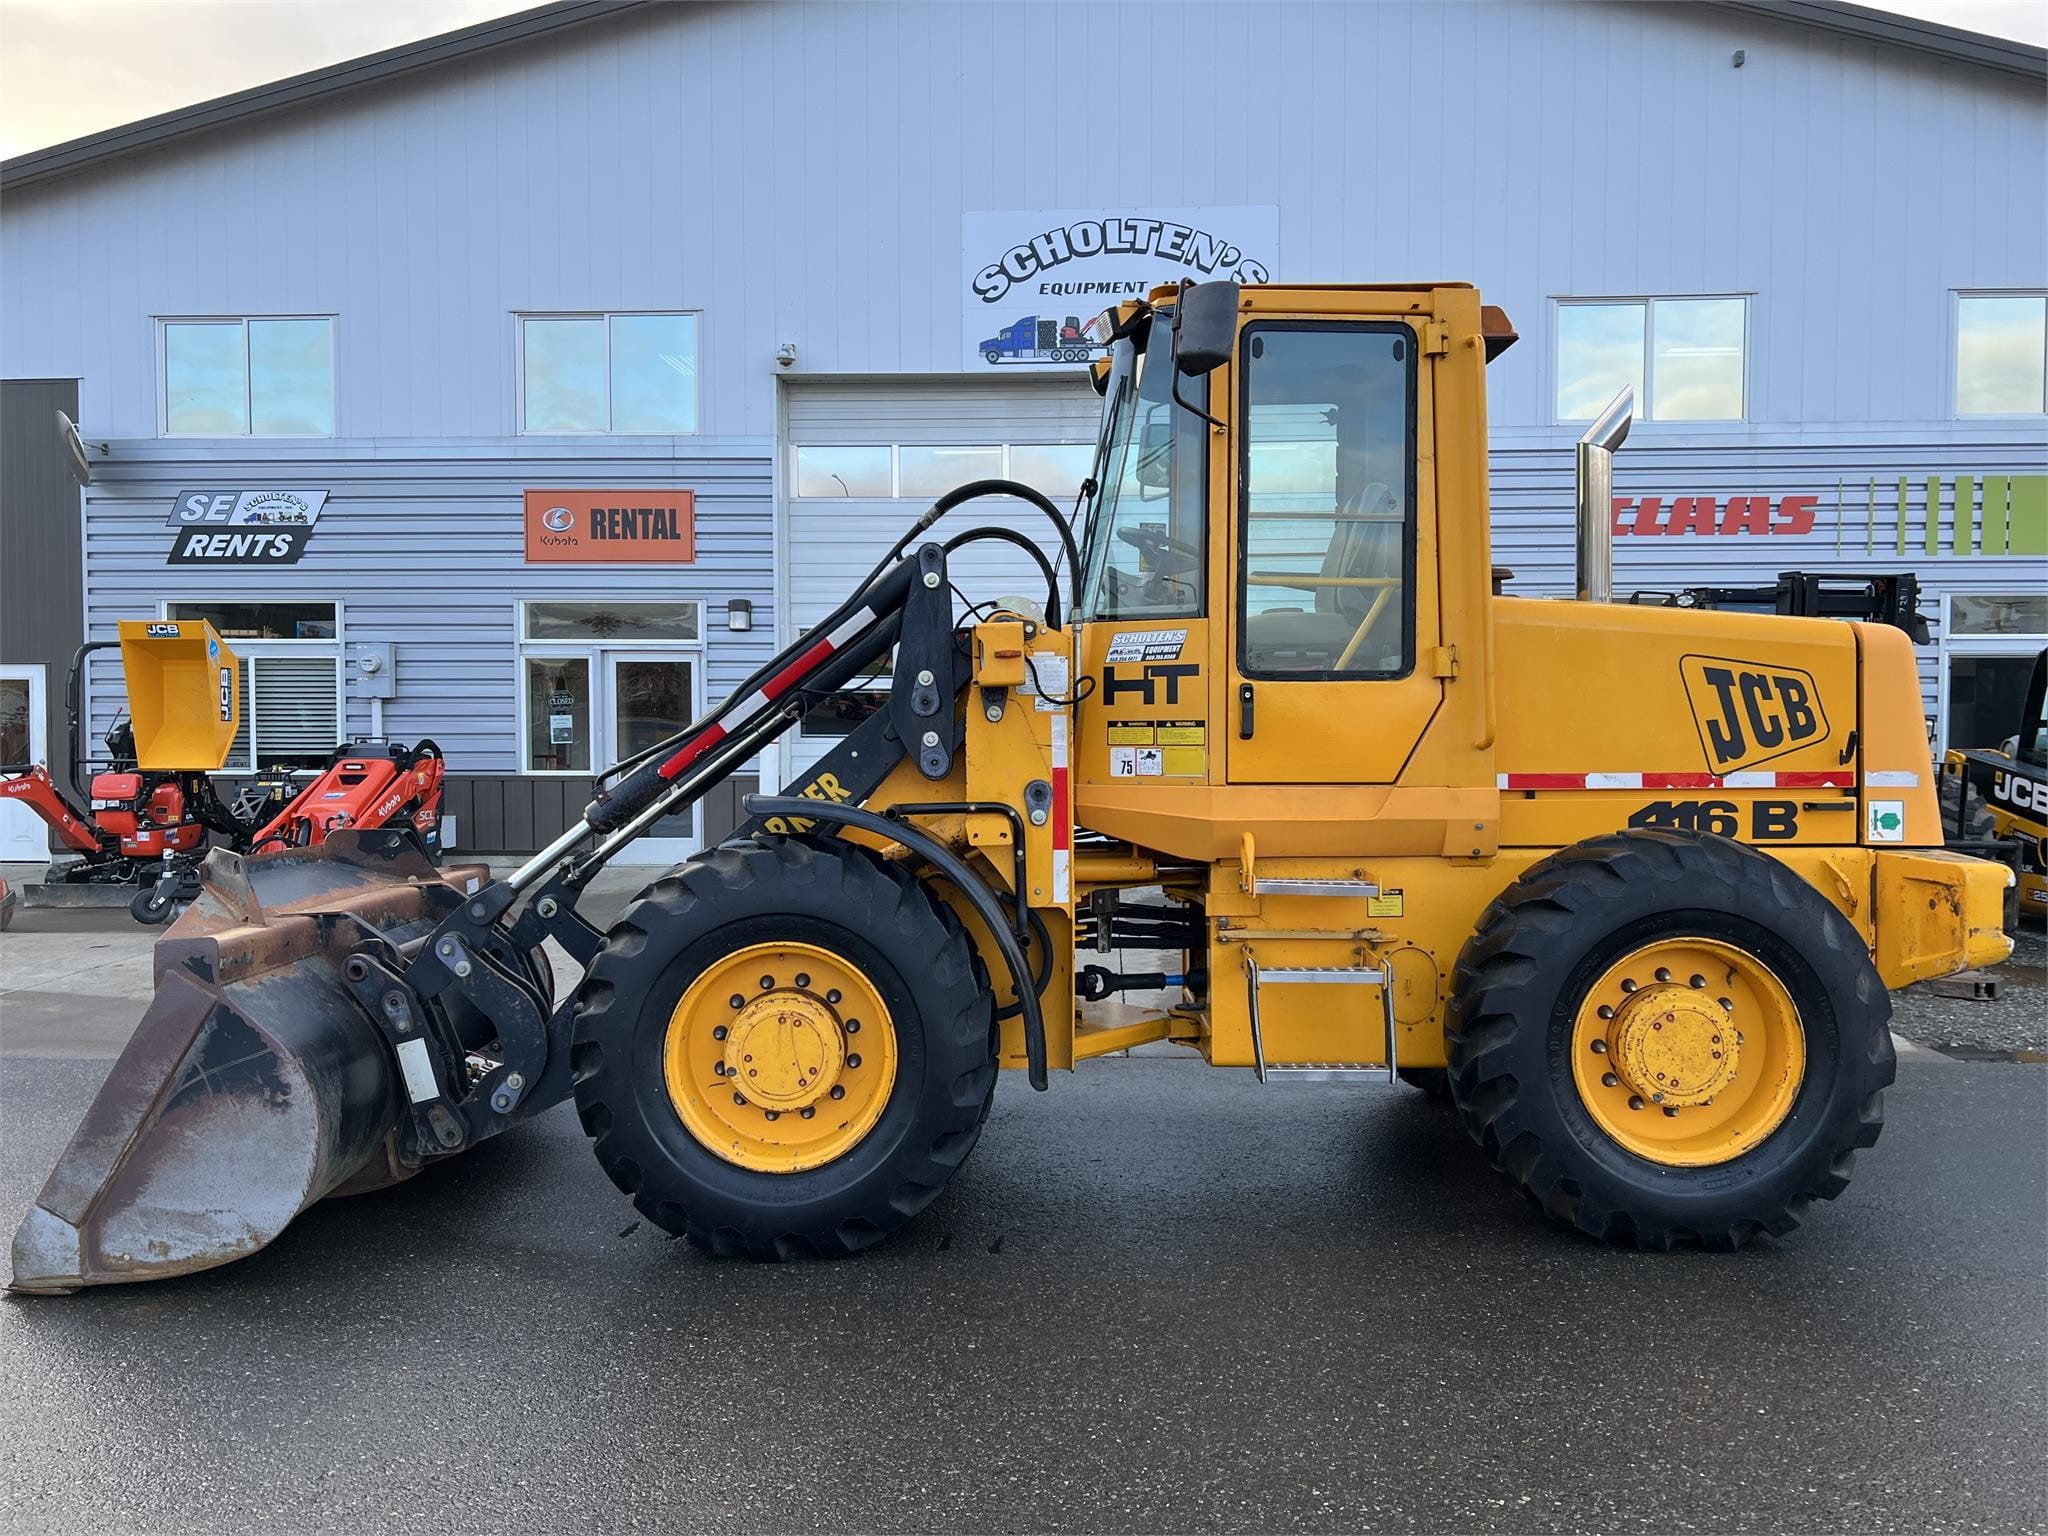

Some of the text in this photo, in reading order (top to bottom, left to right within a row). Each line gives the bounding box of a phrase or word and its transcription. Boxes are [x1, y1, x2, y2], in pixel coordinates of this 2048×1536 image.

[973, 217, 1269, 303] SCHOLTEN'S
[1039, 280, 1149, 296] EQUIPMENT
[180, 493, 236, 522] SE
[243, 491, 309, 512] SCHOLTEN'S
[590, 508, 681, 540] RENTAL
[1611, 496, 1819, 536] CLAAS
[182, 533, 293, 557] RENTS
[540, 535, 579, 546] Kubota
[147, 624, 179, 634] JCB
[1113, 631, 1185, 645] SCHOLTEN'S
[1145, 644, 1182, 654] EQUIPMENT
[221, 668, 229, 721] JCB
[1103, 664, 1200, 706] HT
[549, 697, 574, 705] CLOSED
[1702, 665, 1818, 764] JCB
[1121, 760, 1133, 775] 75
[7, 782, 31, 793] Kubota
[1993, 773, 2048, 815] JCB
[378, 794, 401, 817] Kubota
[1752, 800, 1799, 840] B
